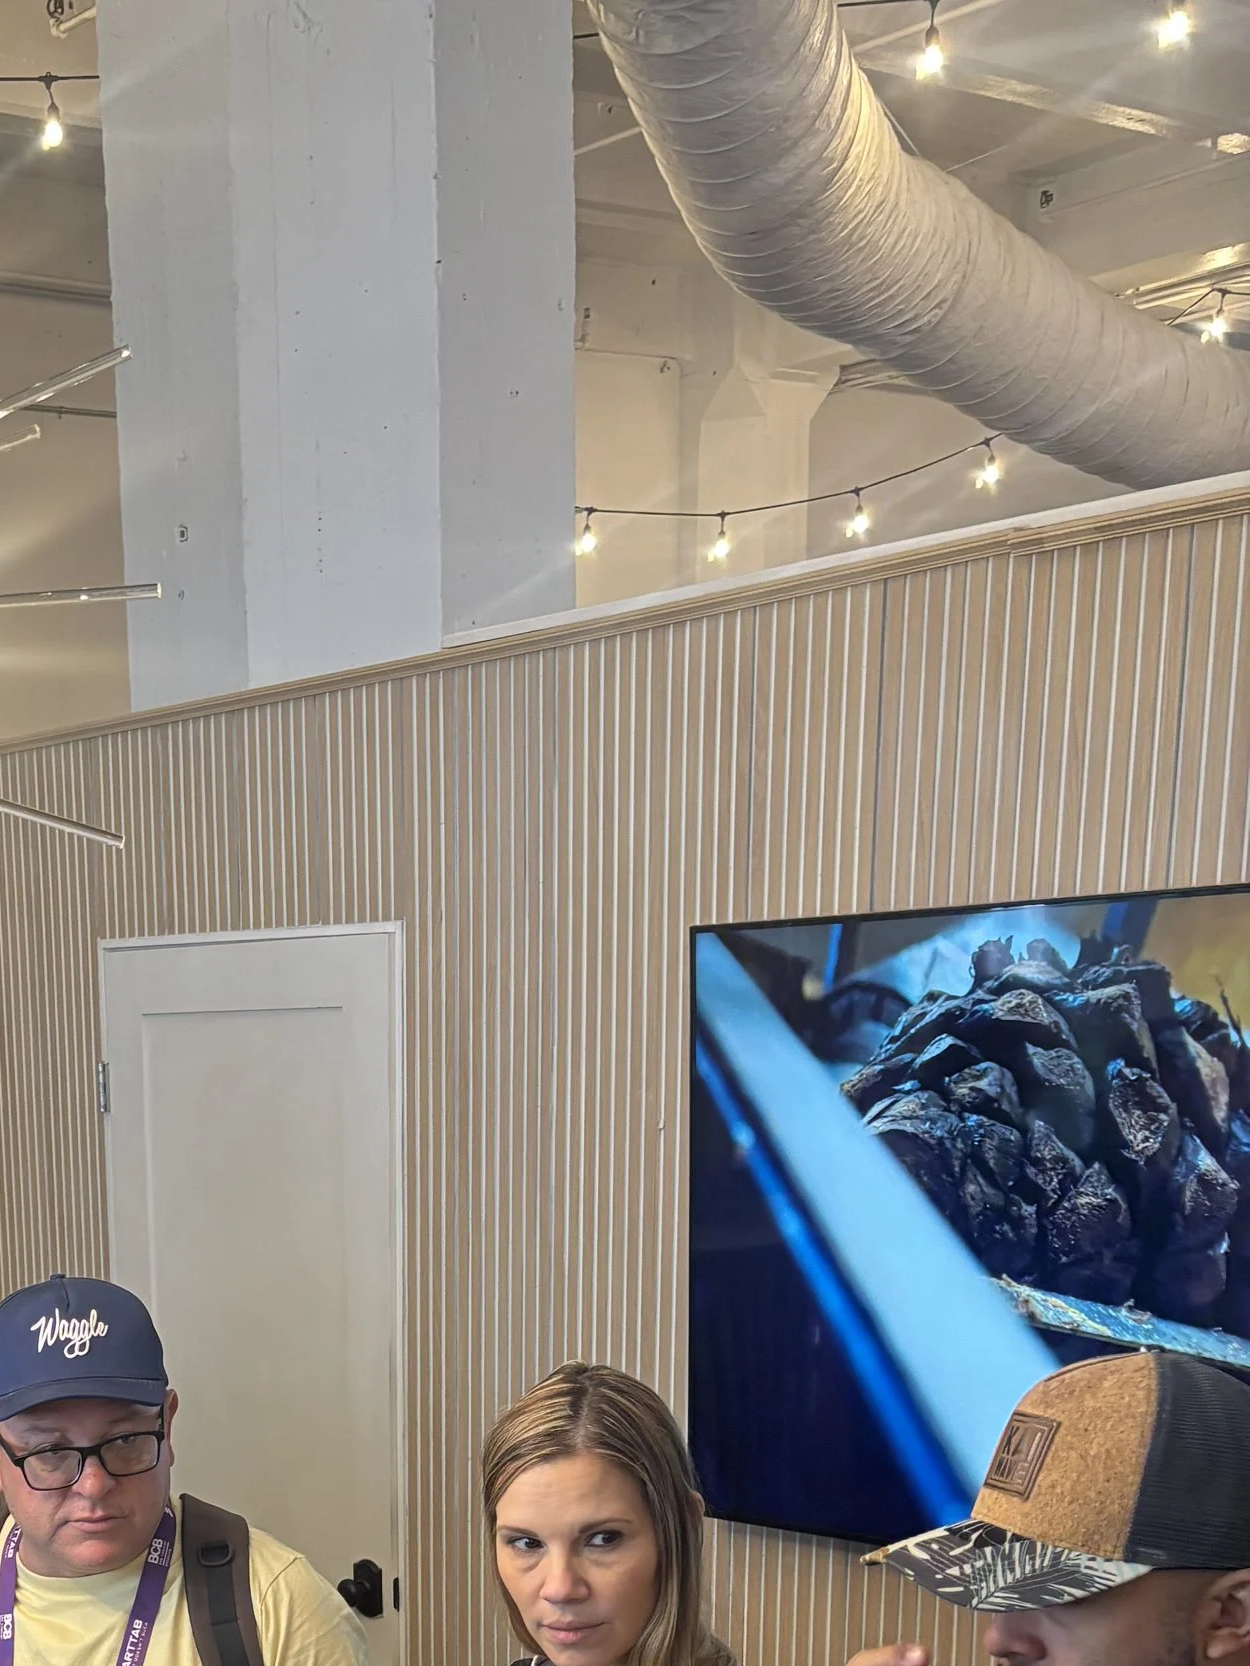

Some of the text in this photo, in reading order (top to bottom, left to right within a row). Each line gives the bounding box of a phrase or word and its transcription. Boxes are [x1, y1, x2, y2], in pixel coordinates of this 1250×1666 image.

[30, 1308, 108, 1358] Waggle
[148, 1538, 163, 1564] BCB
[3, 1613, 12, 1640] BCB
